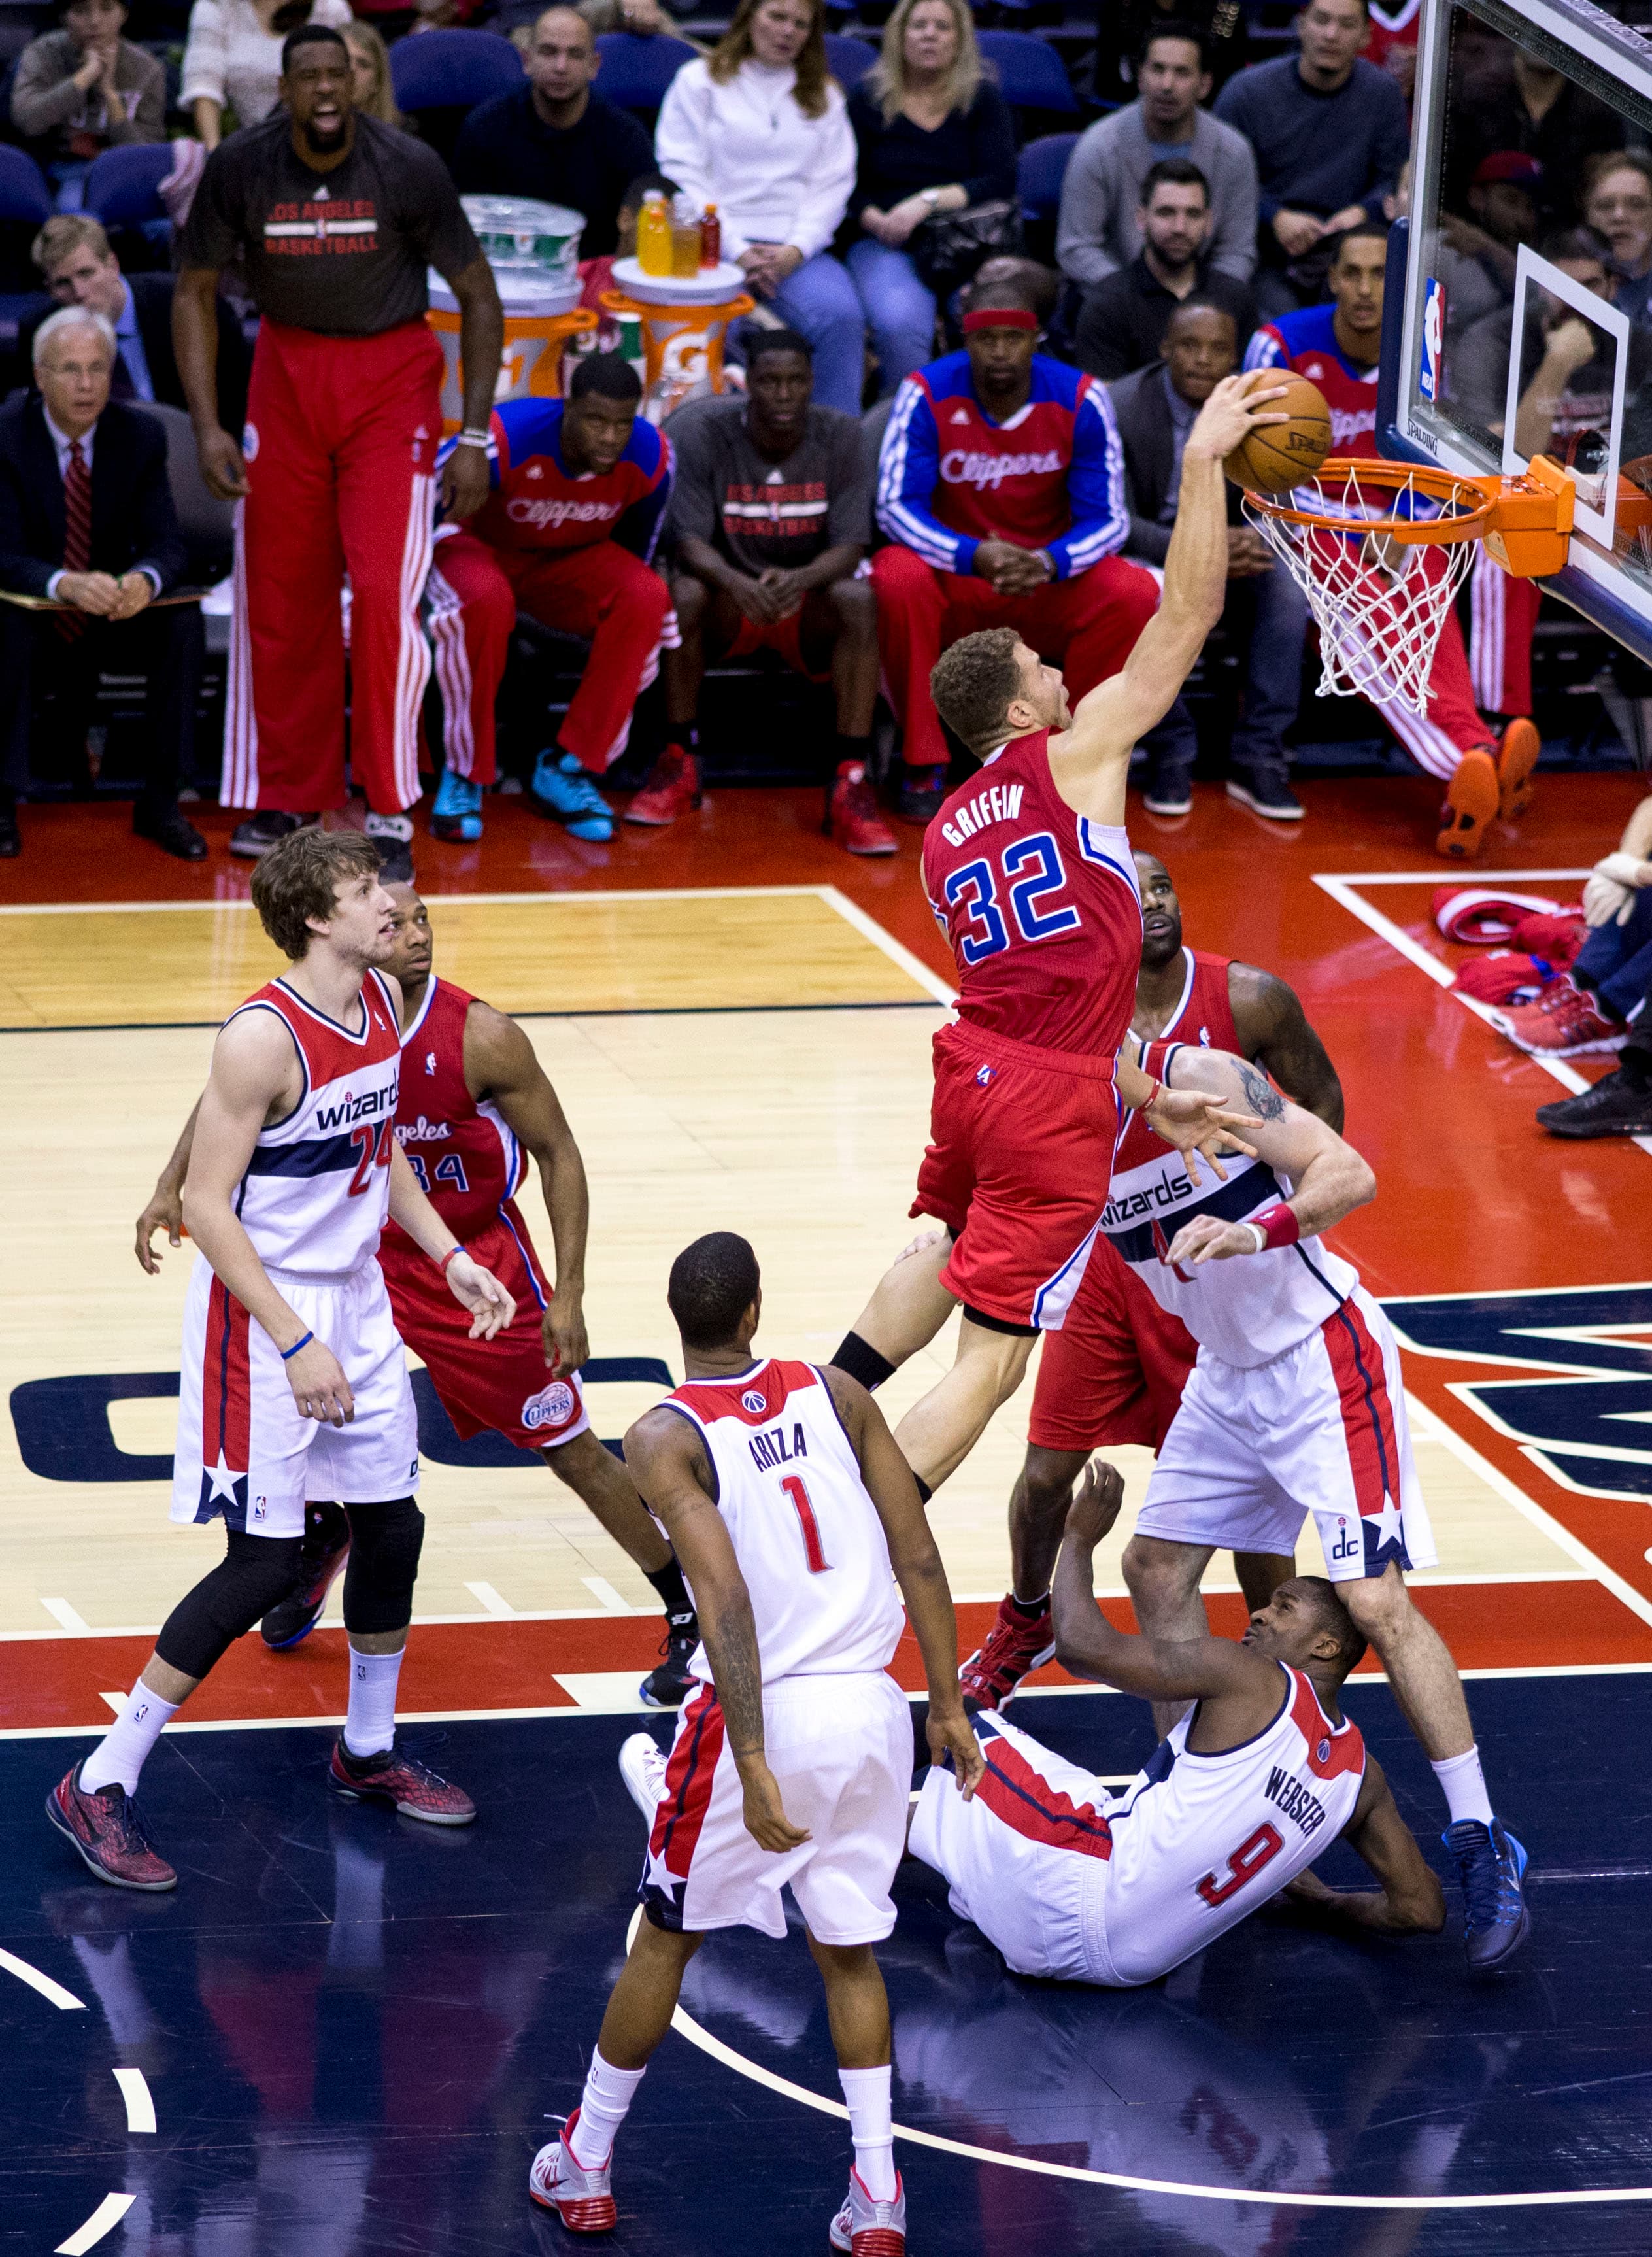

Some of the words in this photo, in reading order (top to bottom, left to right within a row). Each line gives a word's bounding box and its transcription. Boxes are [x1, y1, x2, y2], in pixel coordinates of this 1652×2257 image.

[264, 233, 380, 256] BASKETBALL
[1407, 418, 1438, 456] SPALDING
[939, 449, 1063, 492] Clippers
[941, 784, 1024, 848] GRIFFIN
[944, 831, 1082, 966] 32
[316, 1067, 400, 1131] wizard
[393, 1115, 453, 1147] geles
[348, 1115, 394, 1198] 24
[524, 1399, 571, 1427] CLIPPERS
[748, 1423, 808, 1473] ARIZA
[779, 1472, 835, 1576] 1
[1264, 1765, 1326, 1839] WEBSTER
[1195, 1820, 1286, 1909] 9
